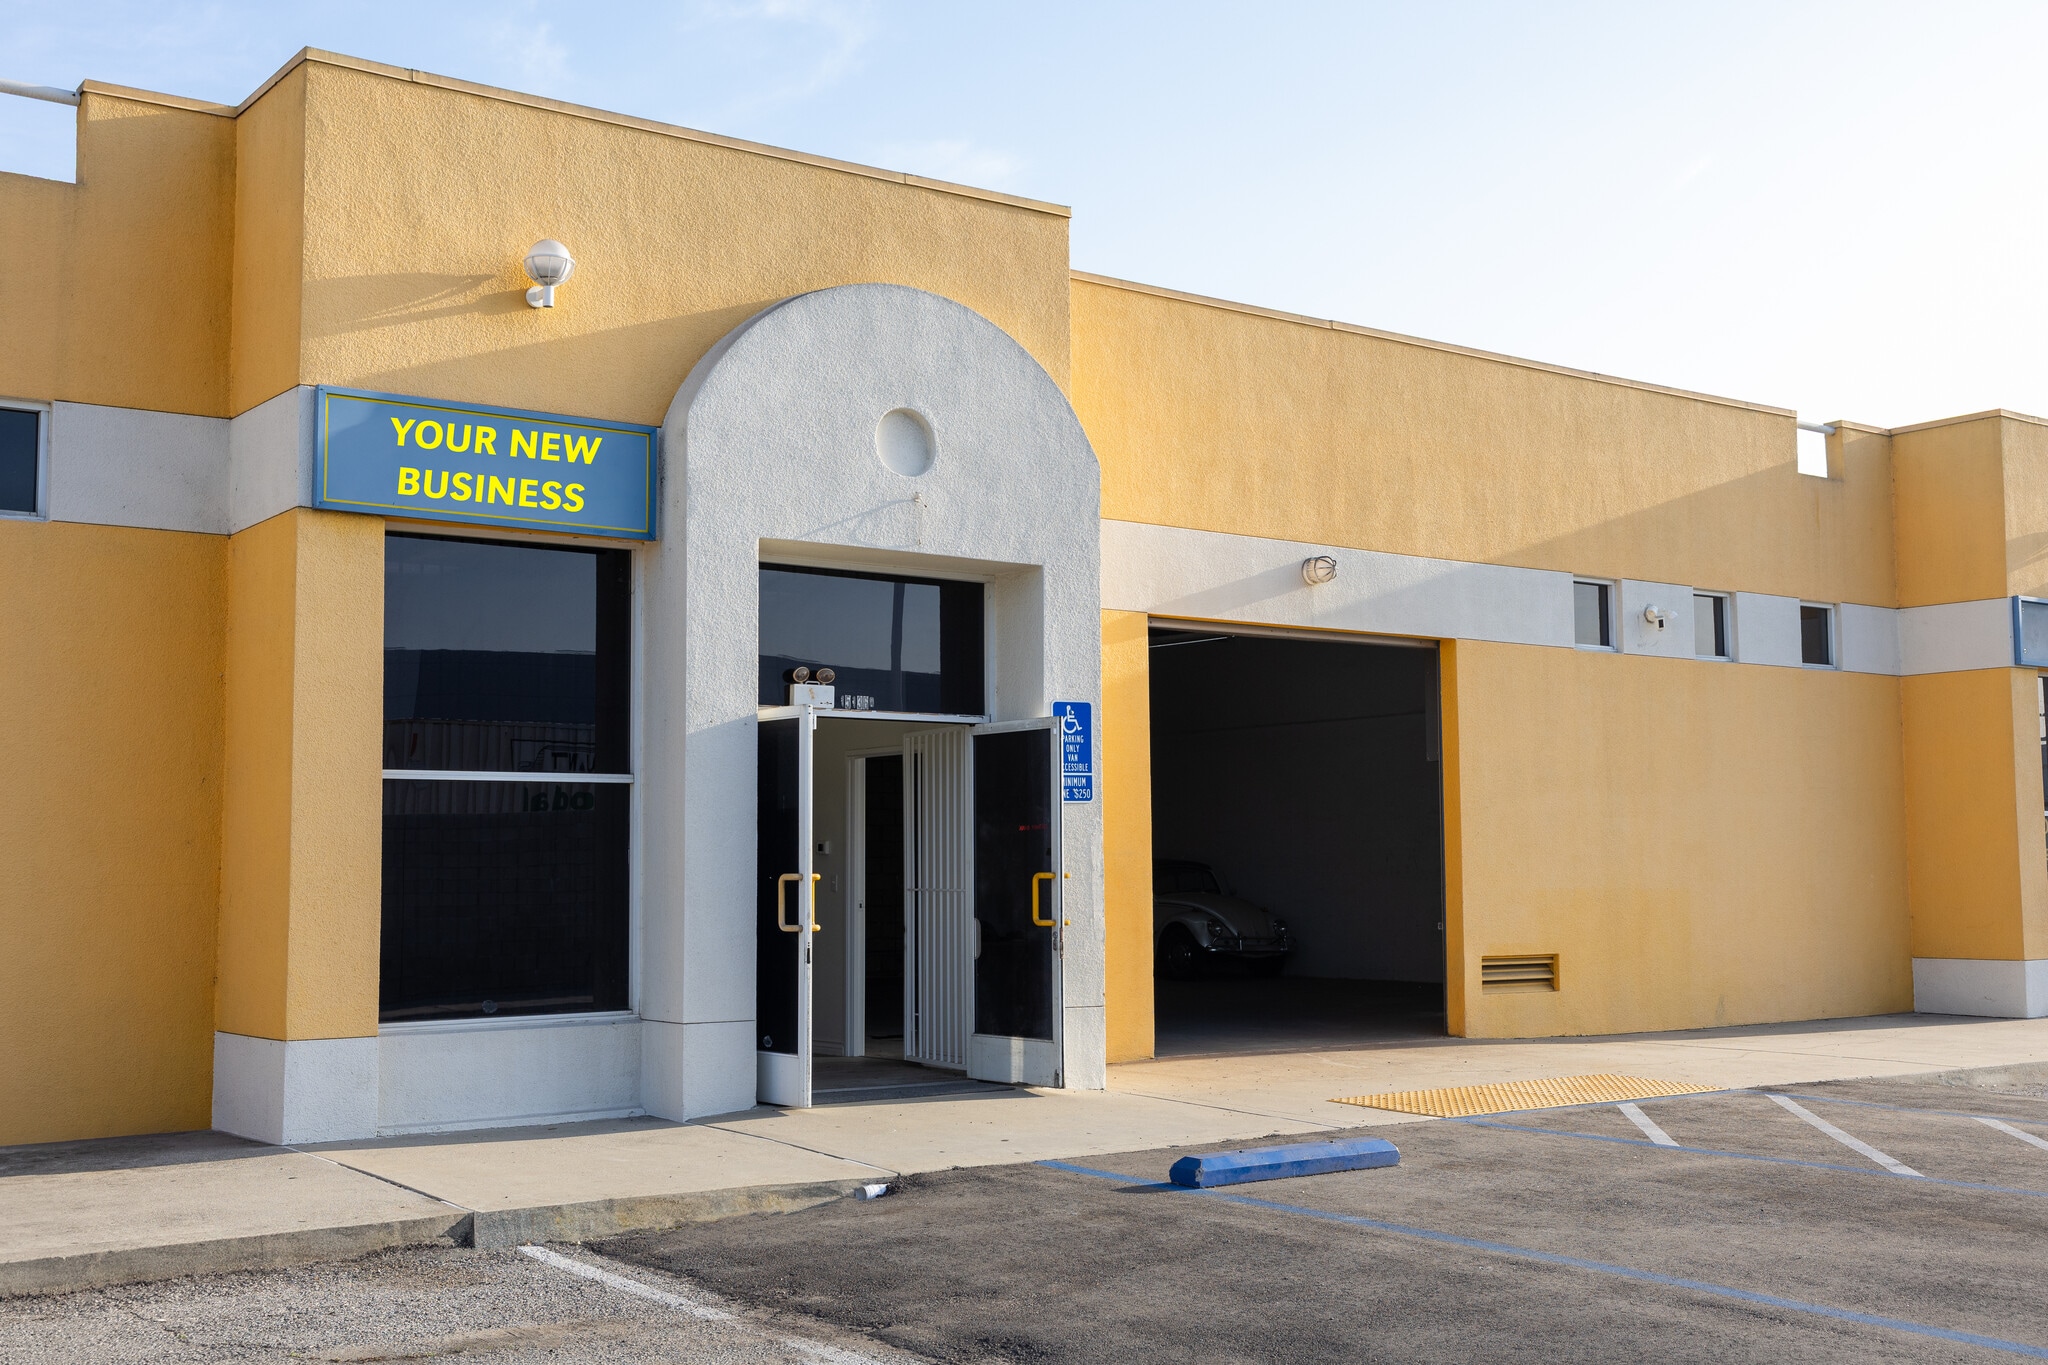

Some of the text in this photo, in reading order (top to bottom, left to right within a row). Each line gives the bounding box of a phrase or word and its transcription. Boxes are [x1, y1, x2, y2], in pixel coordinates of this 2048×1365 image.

[390, 417, 602, 465] YOUR NEW
[397, 467, 585, 513] BUSINESS
[1065, 744, 1080, 753] ONLY
[1067, 754, 1079, 762] VAN
[1073, 788, 1091, 799] $250
